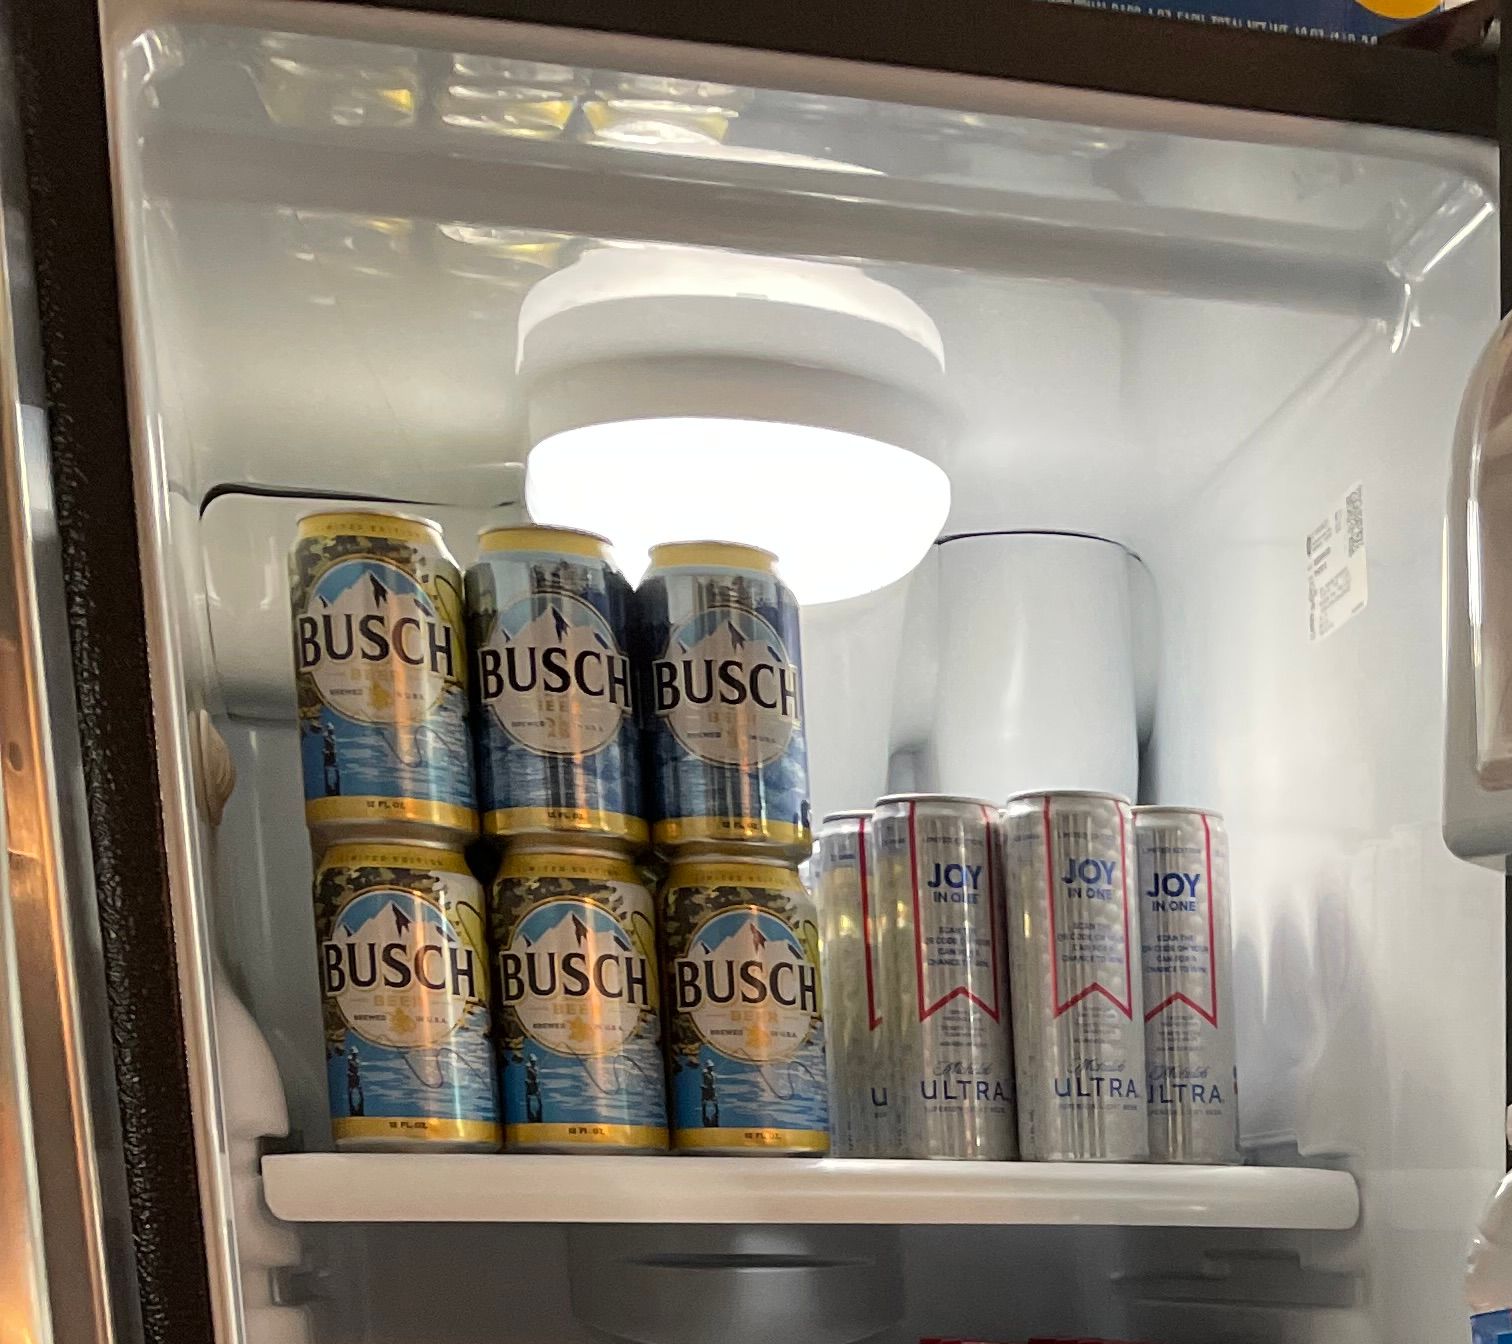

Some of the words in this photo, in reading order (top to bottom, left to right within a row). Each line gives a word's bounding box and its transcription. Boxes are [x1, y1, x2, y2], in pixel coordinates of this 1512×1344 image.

[300, 613, 453, 677] BUSCH
[481, 646, 631, 707] BUSCH
[655, 659, 798, 720] BUSCH
[927, 863, 982, 889] JOY
[1062, 858, 1116, 885] JOY
[933, 891, 948, 903] IN
[1068, 888, 1082, 898] IN
[1086, 888, 1112, 900] ONE
[1147, 873, 1200, 897] JOY
[1152, 901, 1165, 911] IN
[1169, 901, 1197, 911] ONE
[324, 942, 476, 998] BUSCH
[501, 952, 648, 1006] BUSCH
[677, 960, 817, 1013] BUSCH
[920, 1080, 1009, 1101] ULTRA
[1055, 1077, 1137, 1098] ULTRA
